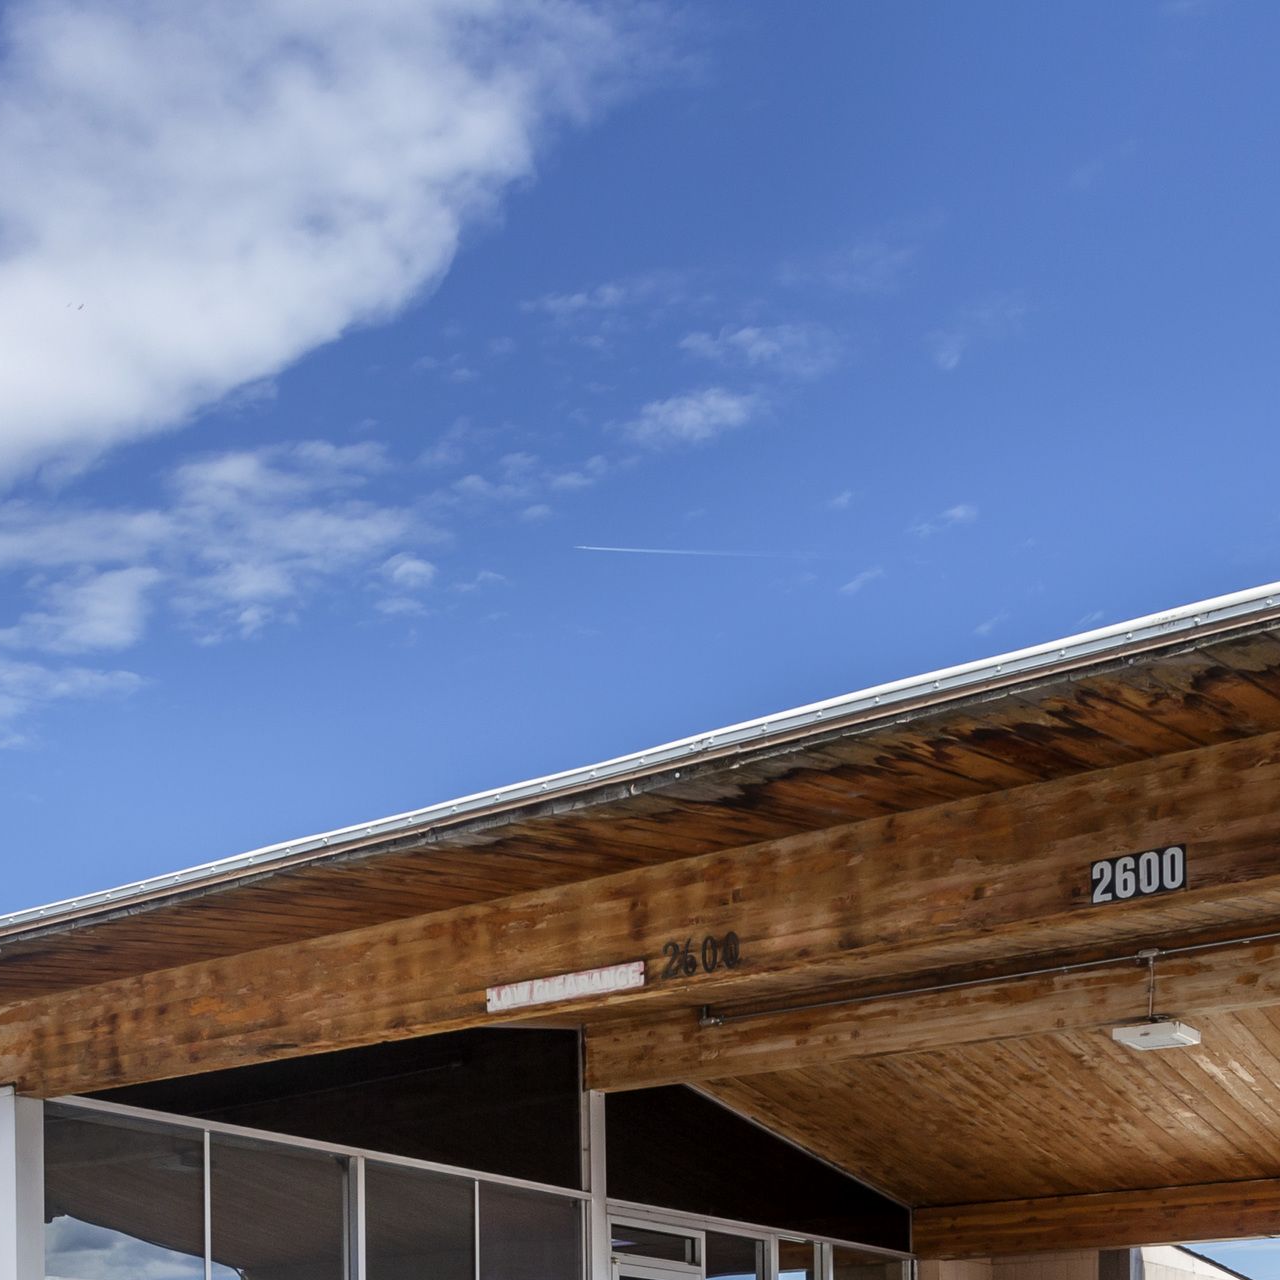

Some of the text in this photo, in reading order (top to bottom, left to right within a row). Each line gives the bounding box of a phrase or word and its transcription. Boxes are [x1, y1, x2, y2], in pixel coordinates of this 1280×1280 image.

[1091, 846, 1184, 904] 2600
[662, 931, 739, 979] 2600
[492, 984, 530, 1010] LOW
